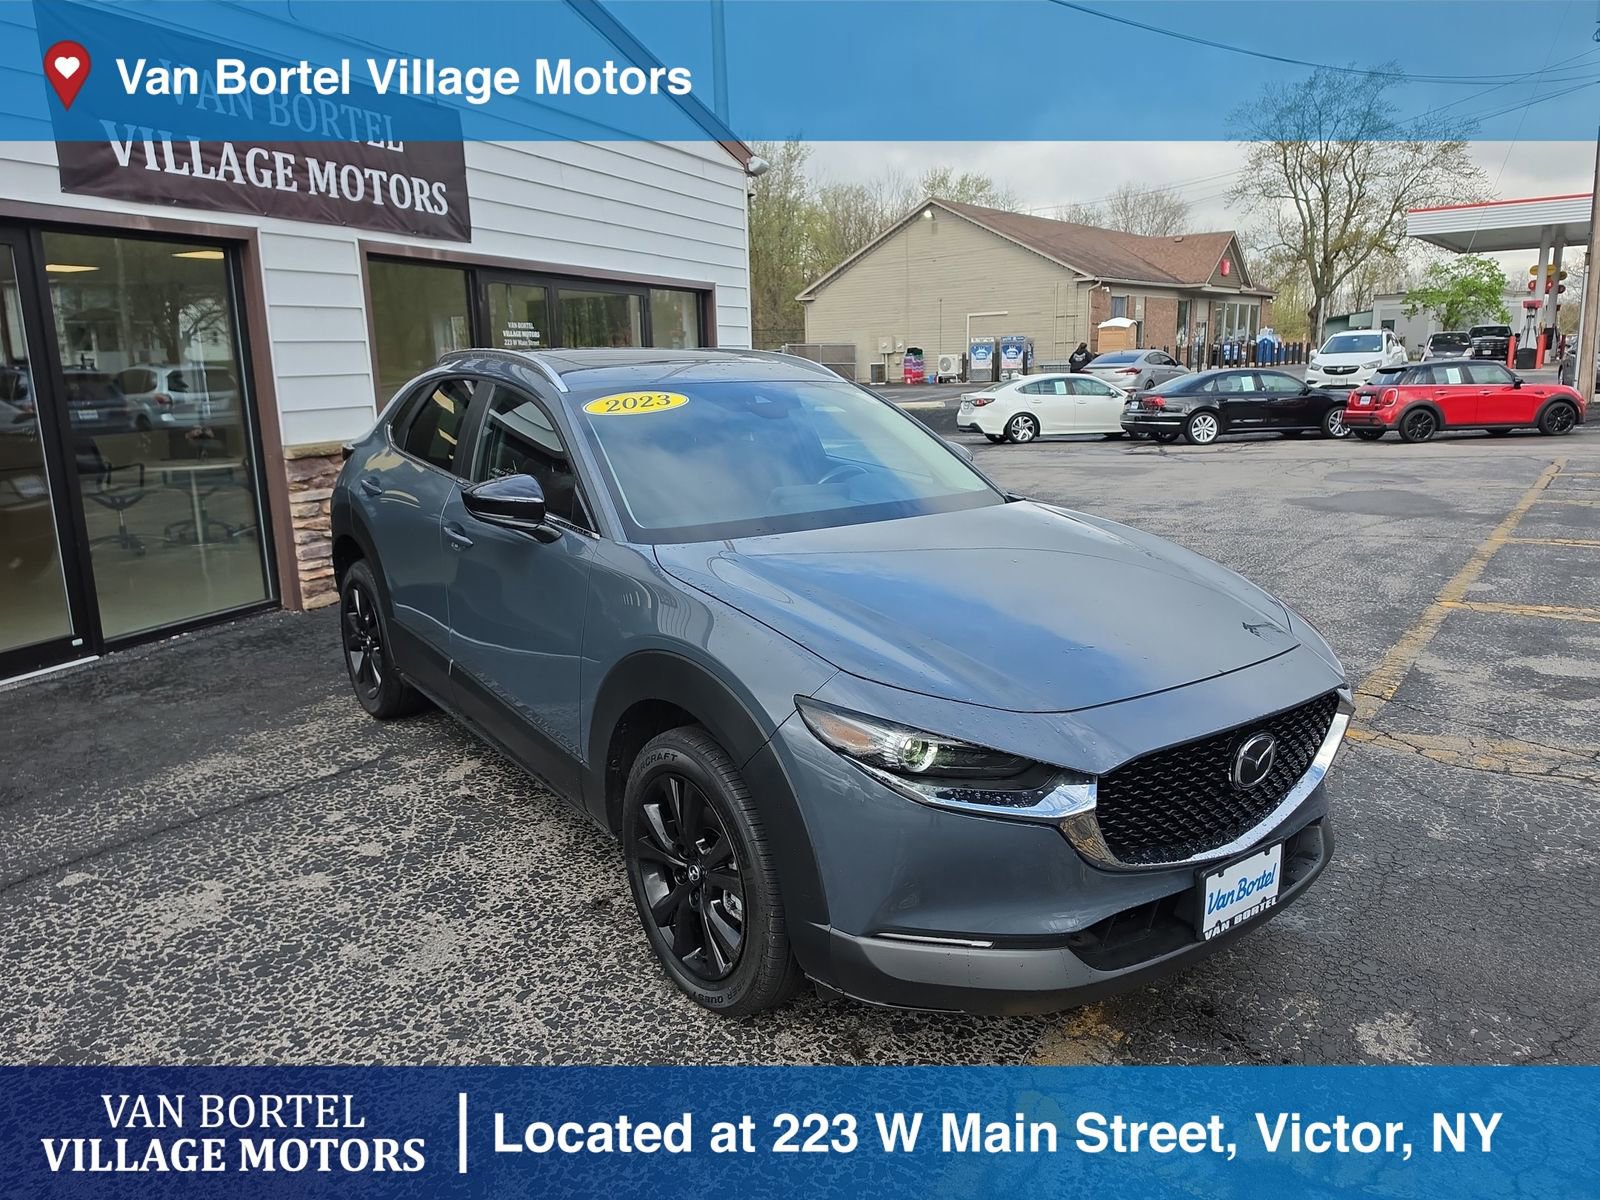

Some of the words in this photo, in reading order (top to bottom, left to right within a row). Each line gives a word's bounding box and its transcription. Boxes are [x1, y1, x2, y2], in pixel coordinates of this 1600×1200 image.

[159, 58, 256, 122] VAN
[268, 86, 404, 153] BORTEL
[100, 119, 298, 193] VILLAGE
[306, 157, 449, 217] MOTORS
[604, 394, 672, 412] 2023
[1207, 888, 1235, 915] Van
[1235, 862, 1277, 902] Bortel
[1203, 919, 1231, 941] VAN
[1233, 896, 1277, 926] BORTEL
